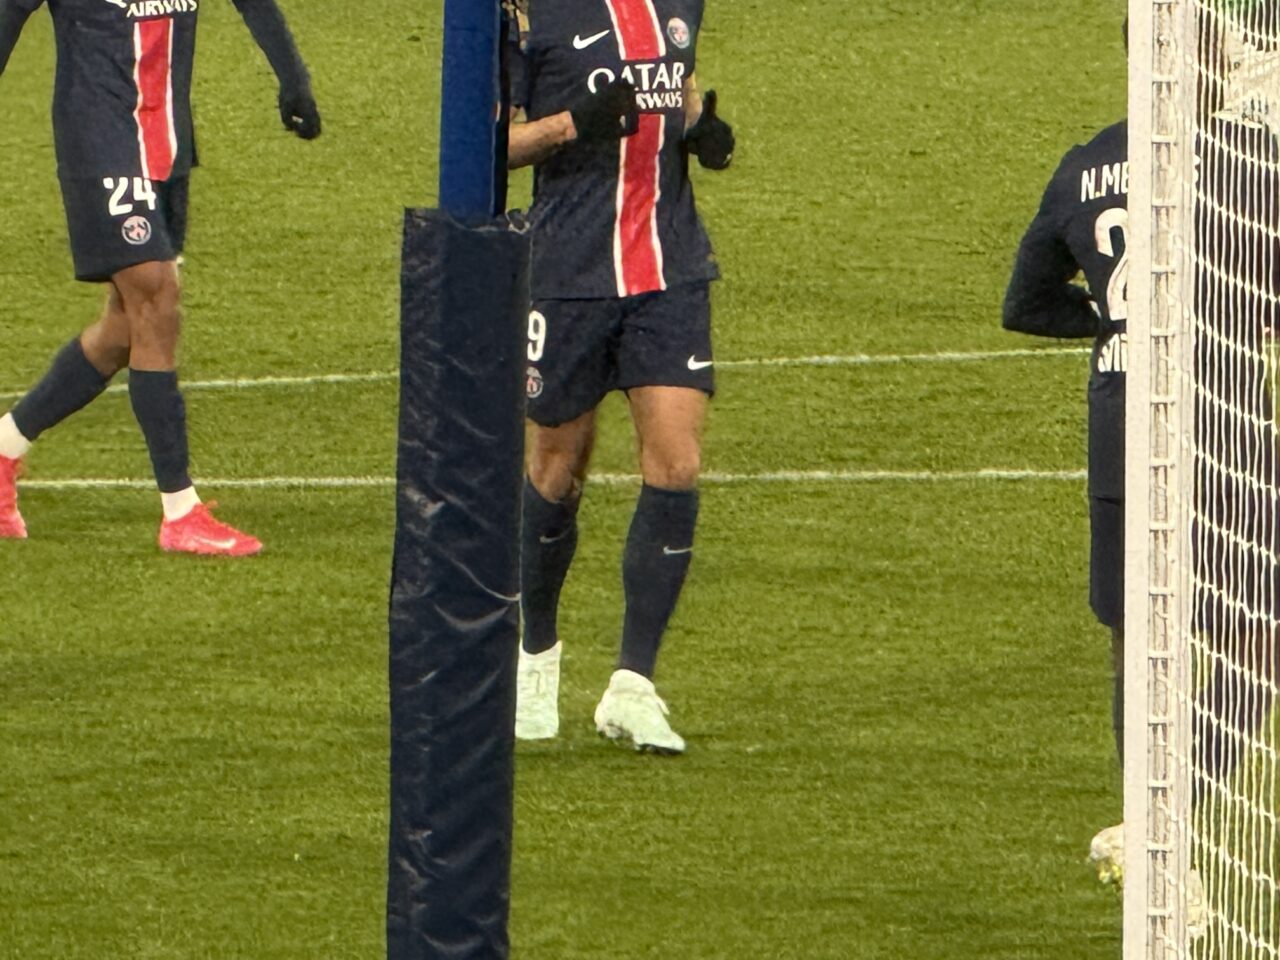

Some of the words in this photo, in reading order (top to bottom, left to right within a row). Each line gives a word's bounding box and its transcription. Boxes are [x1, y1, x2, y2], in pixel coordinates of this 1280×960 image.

[103, 176, 157, 217] 24
[1094, 206, 1129, 322] 2
[526, 310, 547, 362] 9
